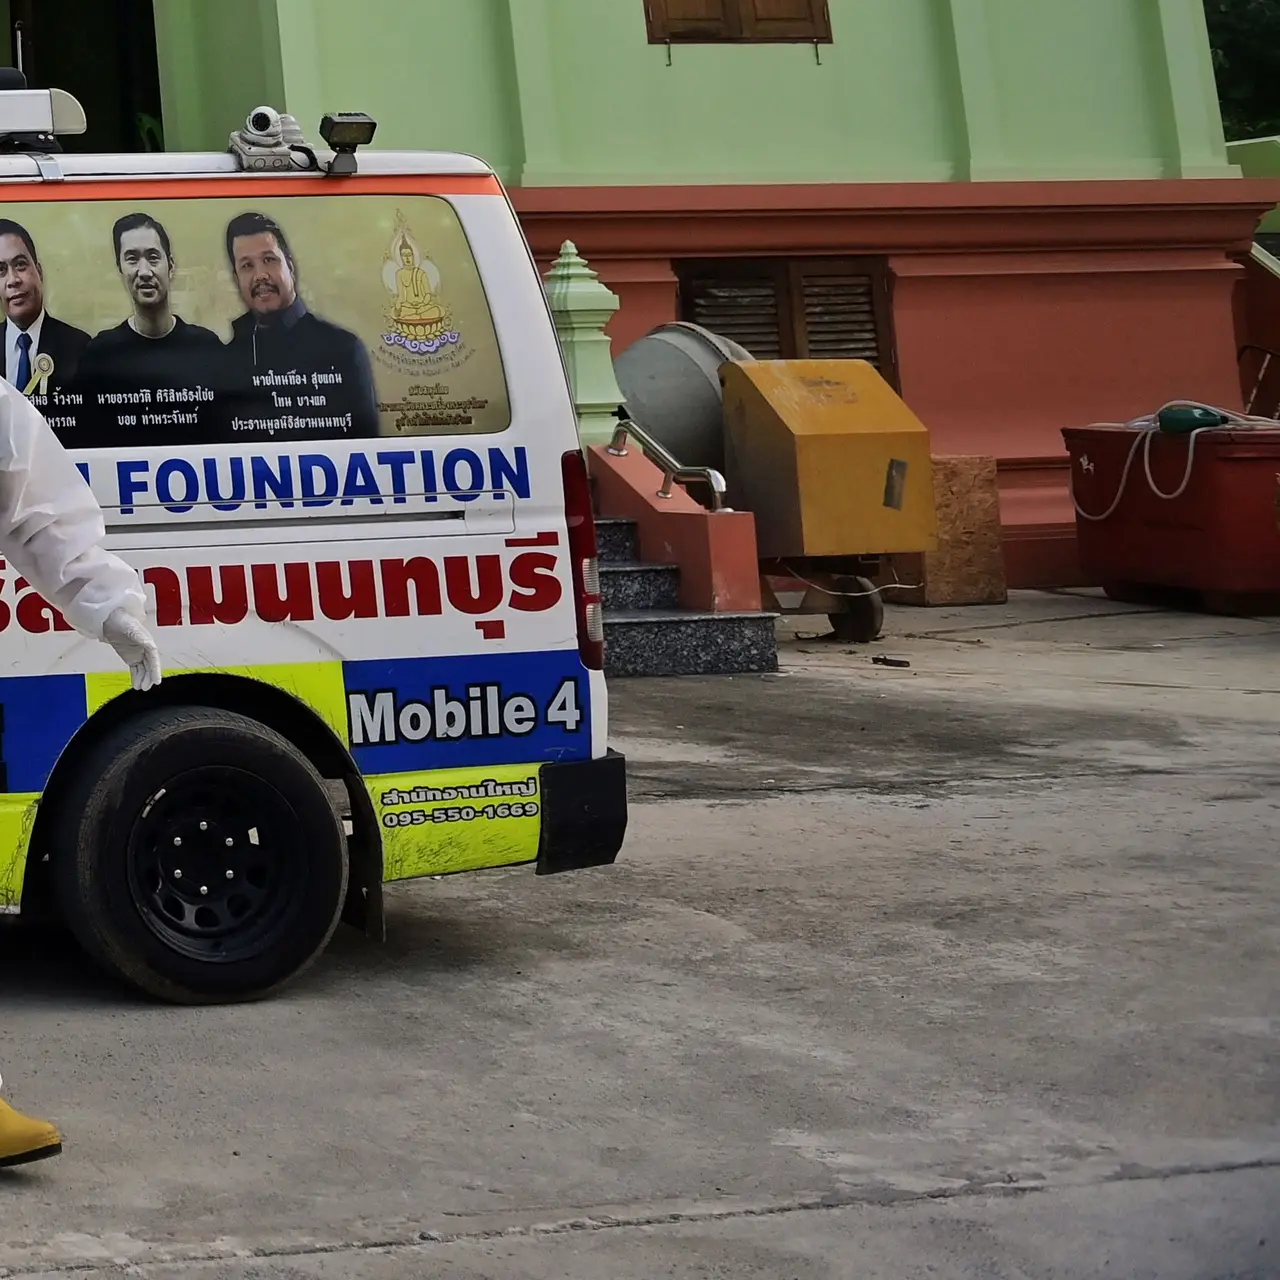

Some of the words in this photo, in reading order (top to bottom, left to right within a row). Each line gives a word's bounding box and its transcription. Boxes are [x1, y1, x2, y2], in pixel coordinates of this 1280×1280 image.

[272, 391, 292, 407] โทน
[297, 395, 327, 407] บางแค
[117, 415, 137, 426] บอย
[231, 413, 352, 435] ประธานมูลนิธิสยามนนทบุรี
[116, 446, 532, 515] FOUNDATION
[348, 686, 536, 744] Mobile
[547, 680, 580, 730] 4
[382, 778, 538, 805] สำนักงานใหญ่
[383, 802, 539, 827] 095-550-1669
